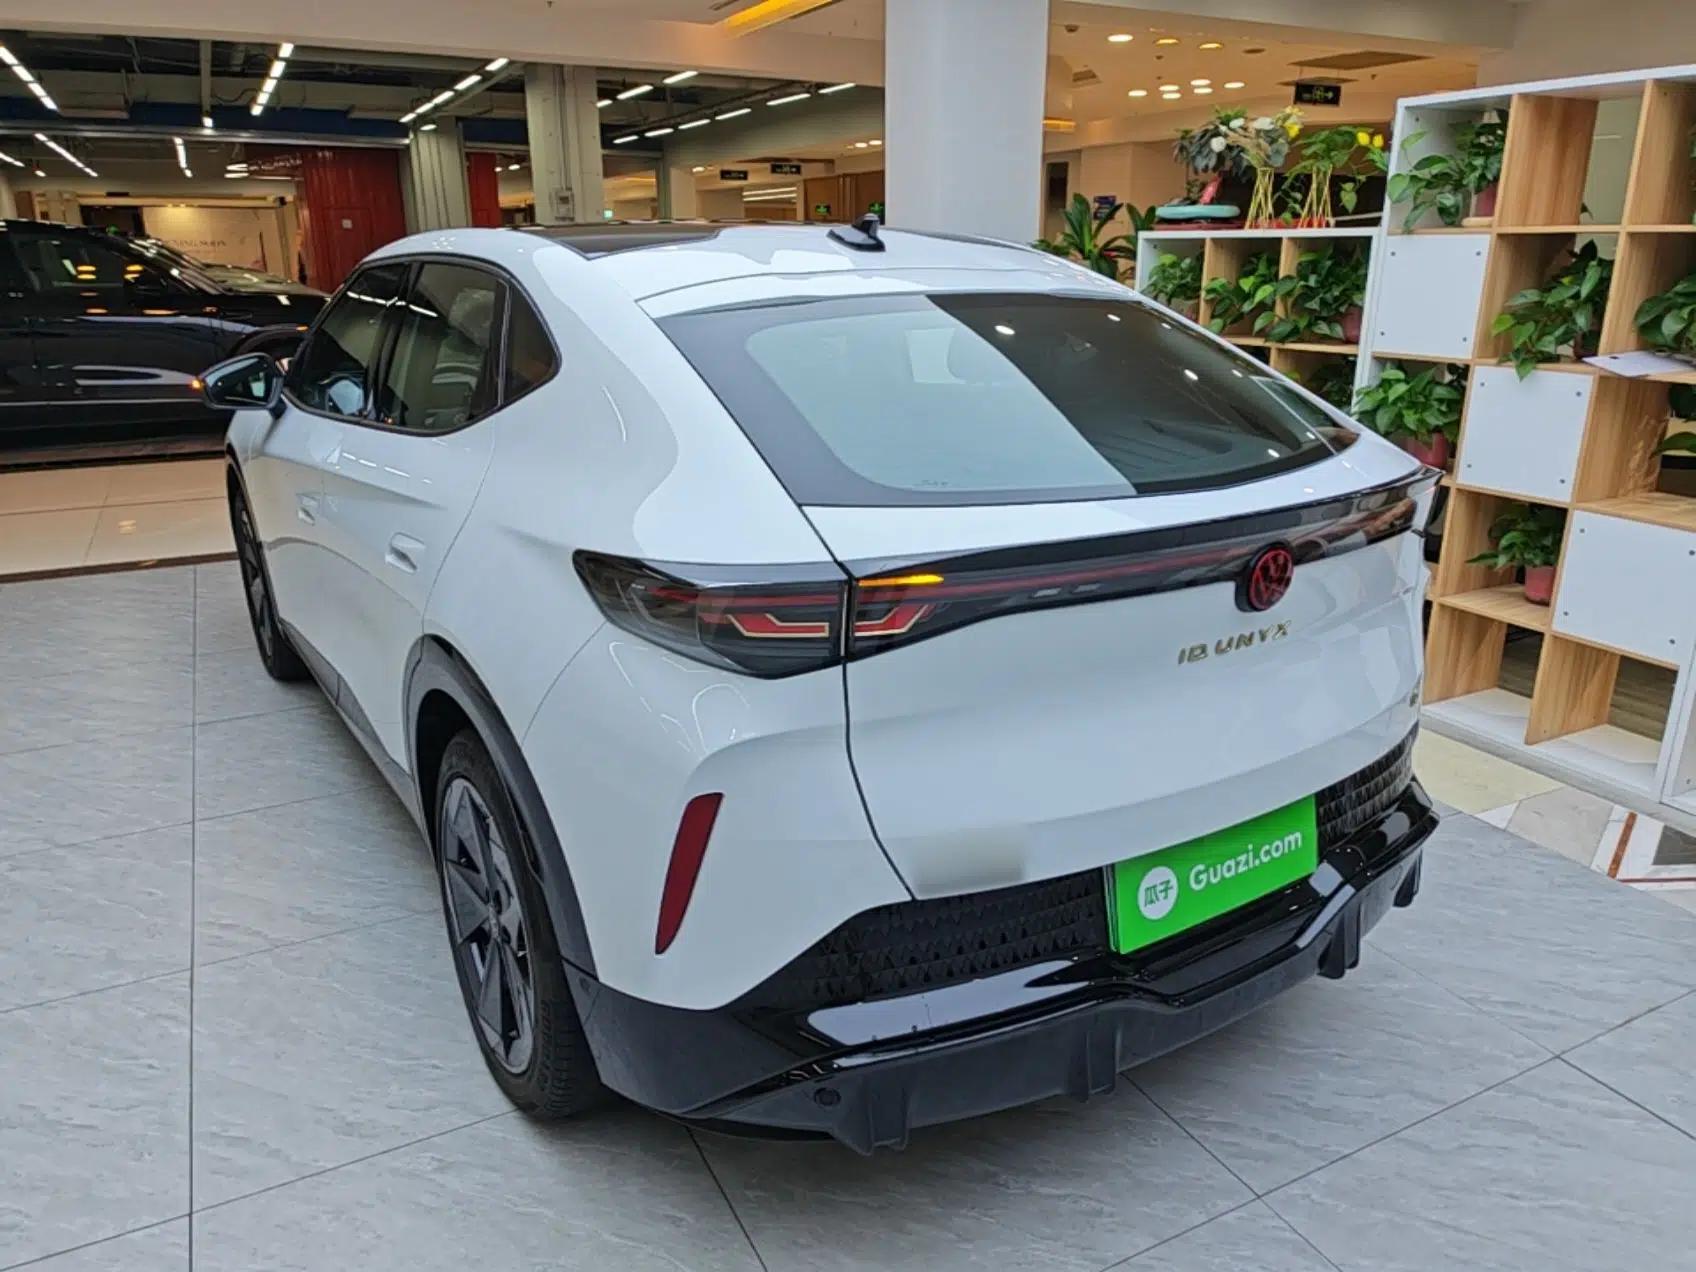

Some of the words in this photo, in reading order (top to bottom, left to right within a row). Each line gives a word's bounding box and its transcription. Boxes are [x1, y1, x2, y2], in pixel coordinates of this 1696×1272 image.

[1215, 620, 1291, 654] UNYX
[1189, 831, 1302, 891] Guazi.com
[1144, 879, 1173, 907] 瓜子
